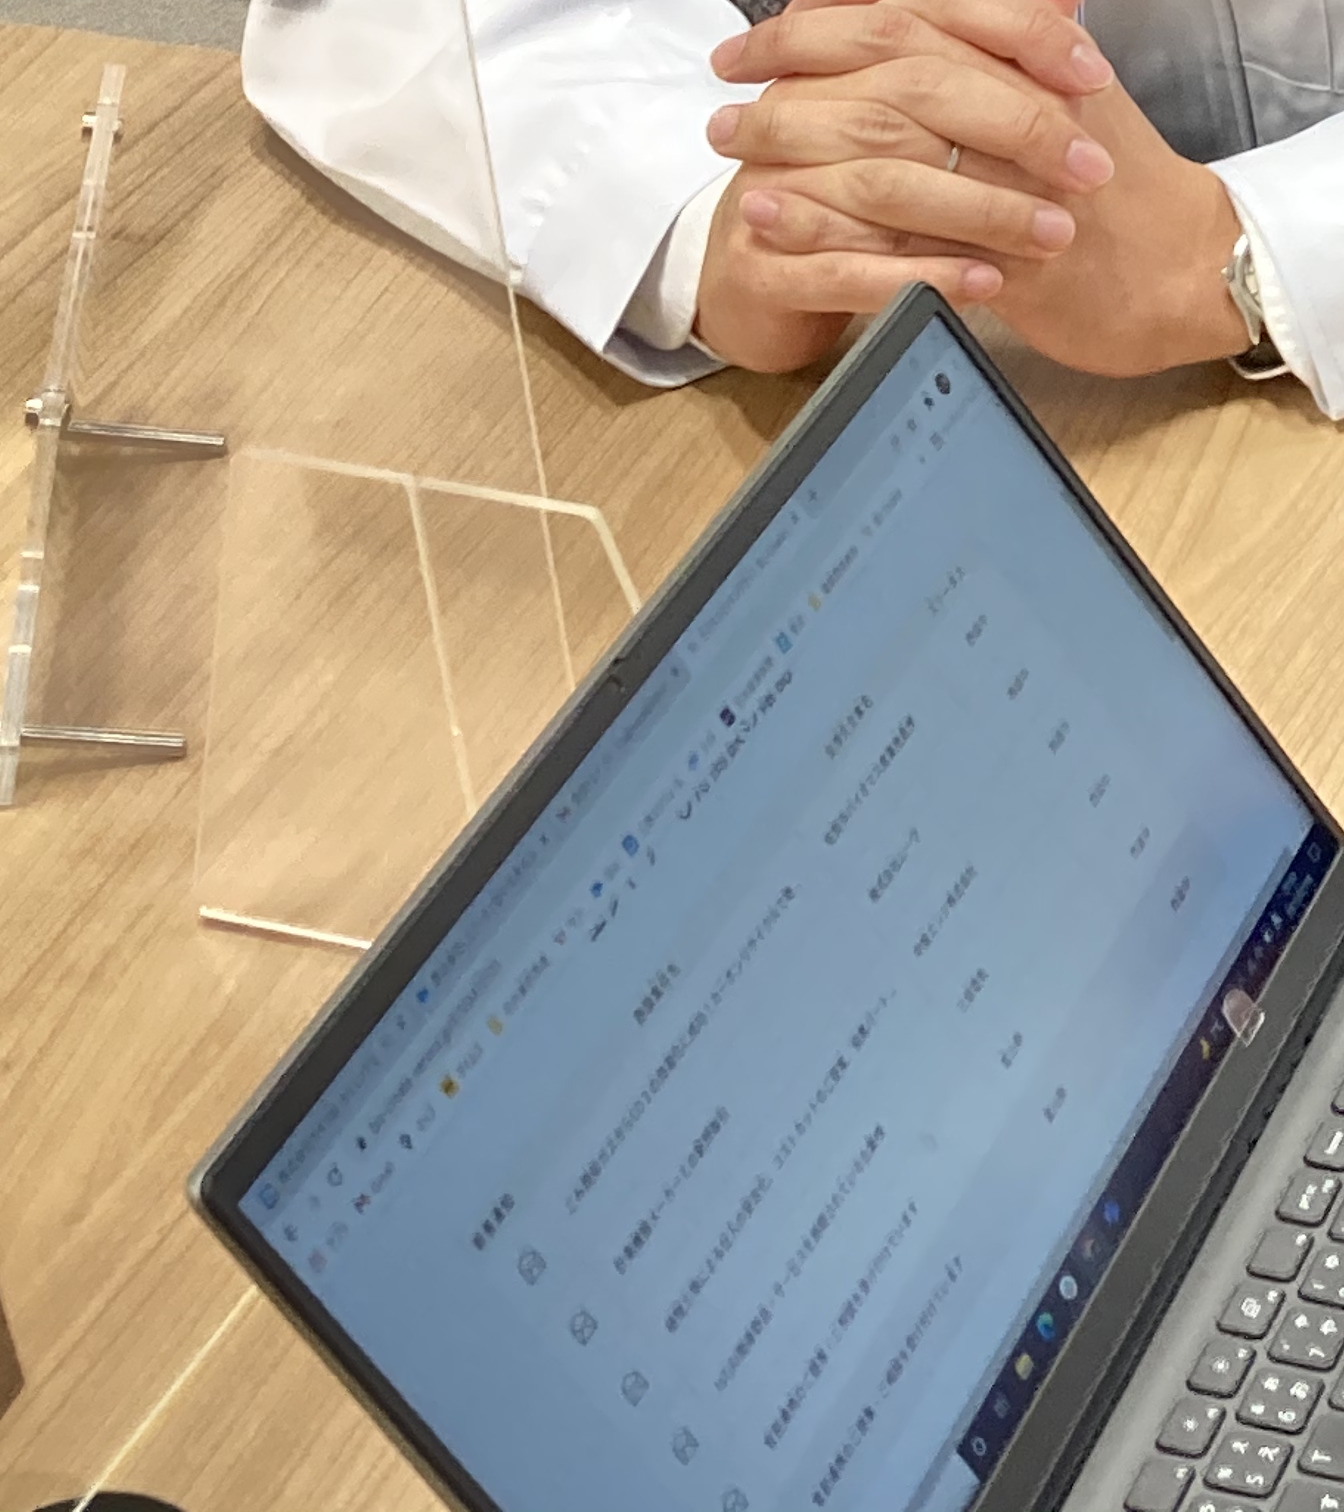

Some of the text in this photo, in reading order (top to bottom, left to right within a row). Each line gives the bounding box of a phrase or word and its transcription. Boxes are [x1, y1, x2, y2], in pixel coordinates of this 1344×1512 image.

[1278, 1411, 1296, 1423] 6
[1310, 1449, 1332, 1463] T
[1246, 1474, 1264, 1487] 5
